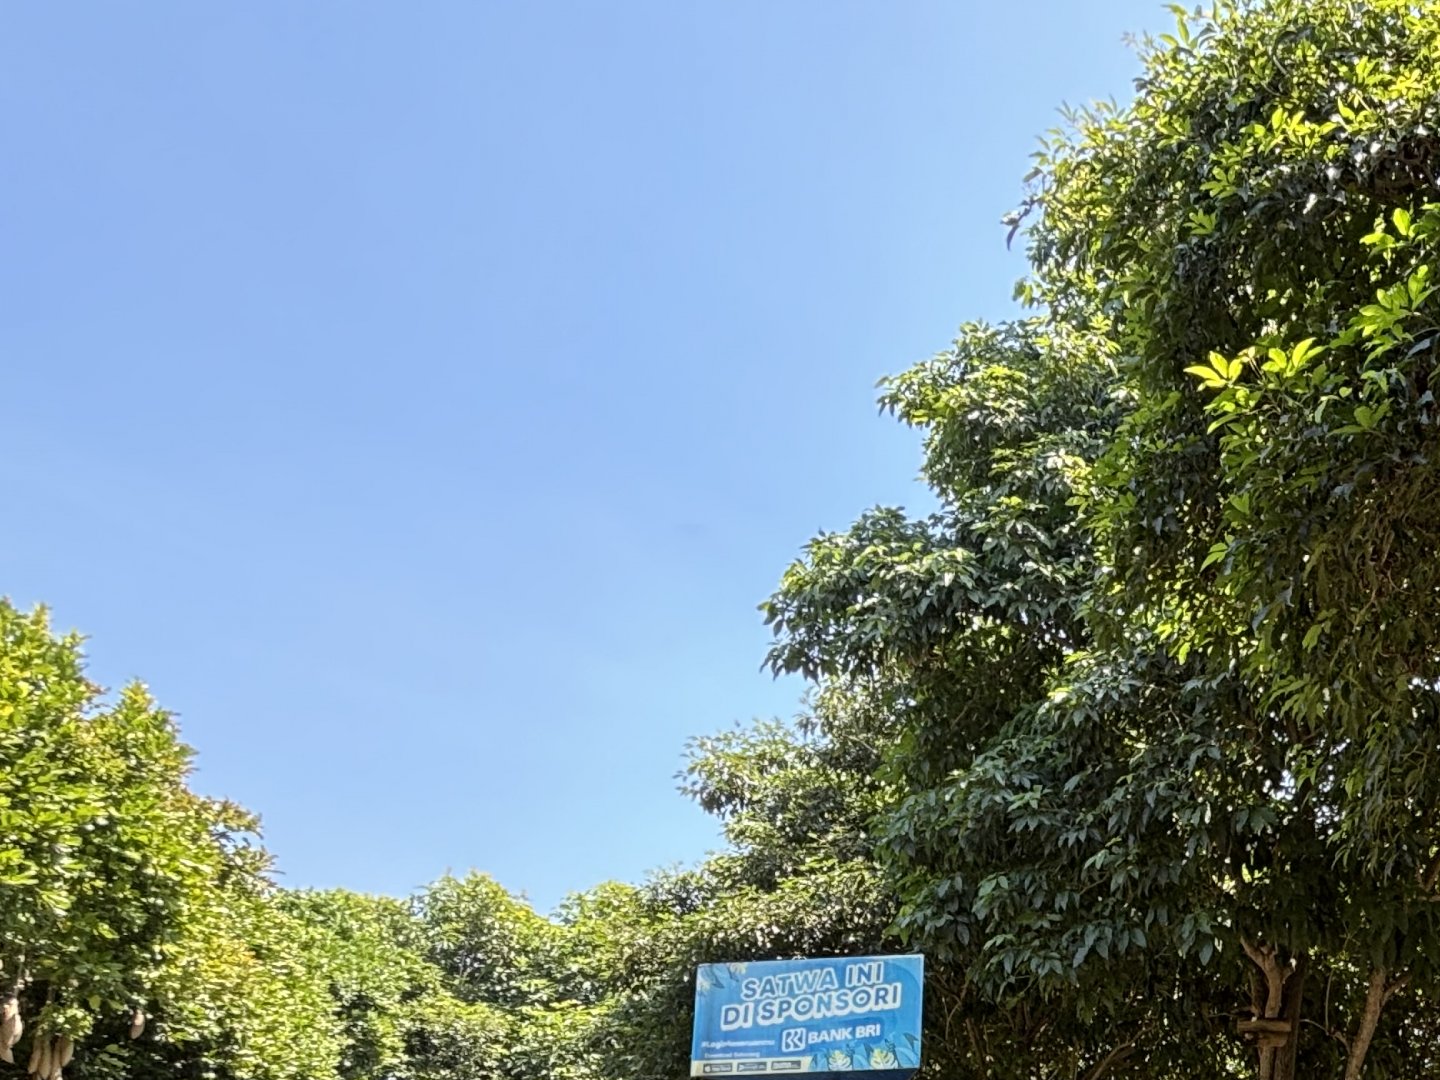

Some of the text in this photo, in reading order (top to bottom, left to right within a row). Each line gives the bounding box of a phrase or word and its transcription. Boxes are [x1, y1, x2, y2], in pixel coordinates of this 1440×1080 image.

[743, 961, 884, 1000] SATWA INI
[721, 983, 901, 1030] DI SPONSORI
[808, 1024, 881, 1043] BANK BRI
